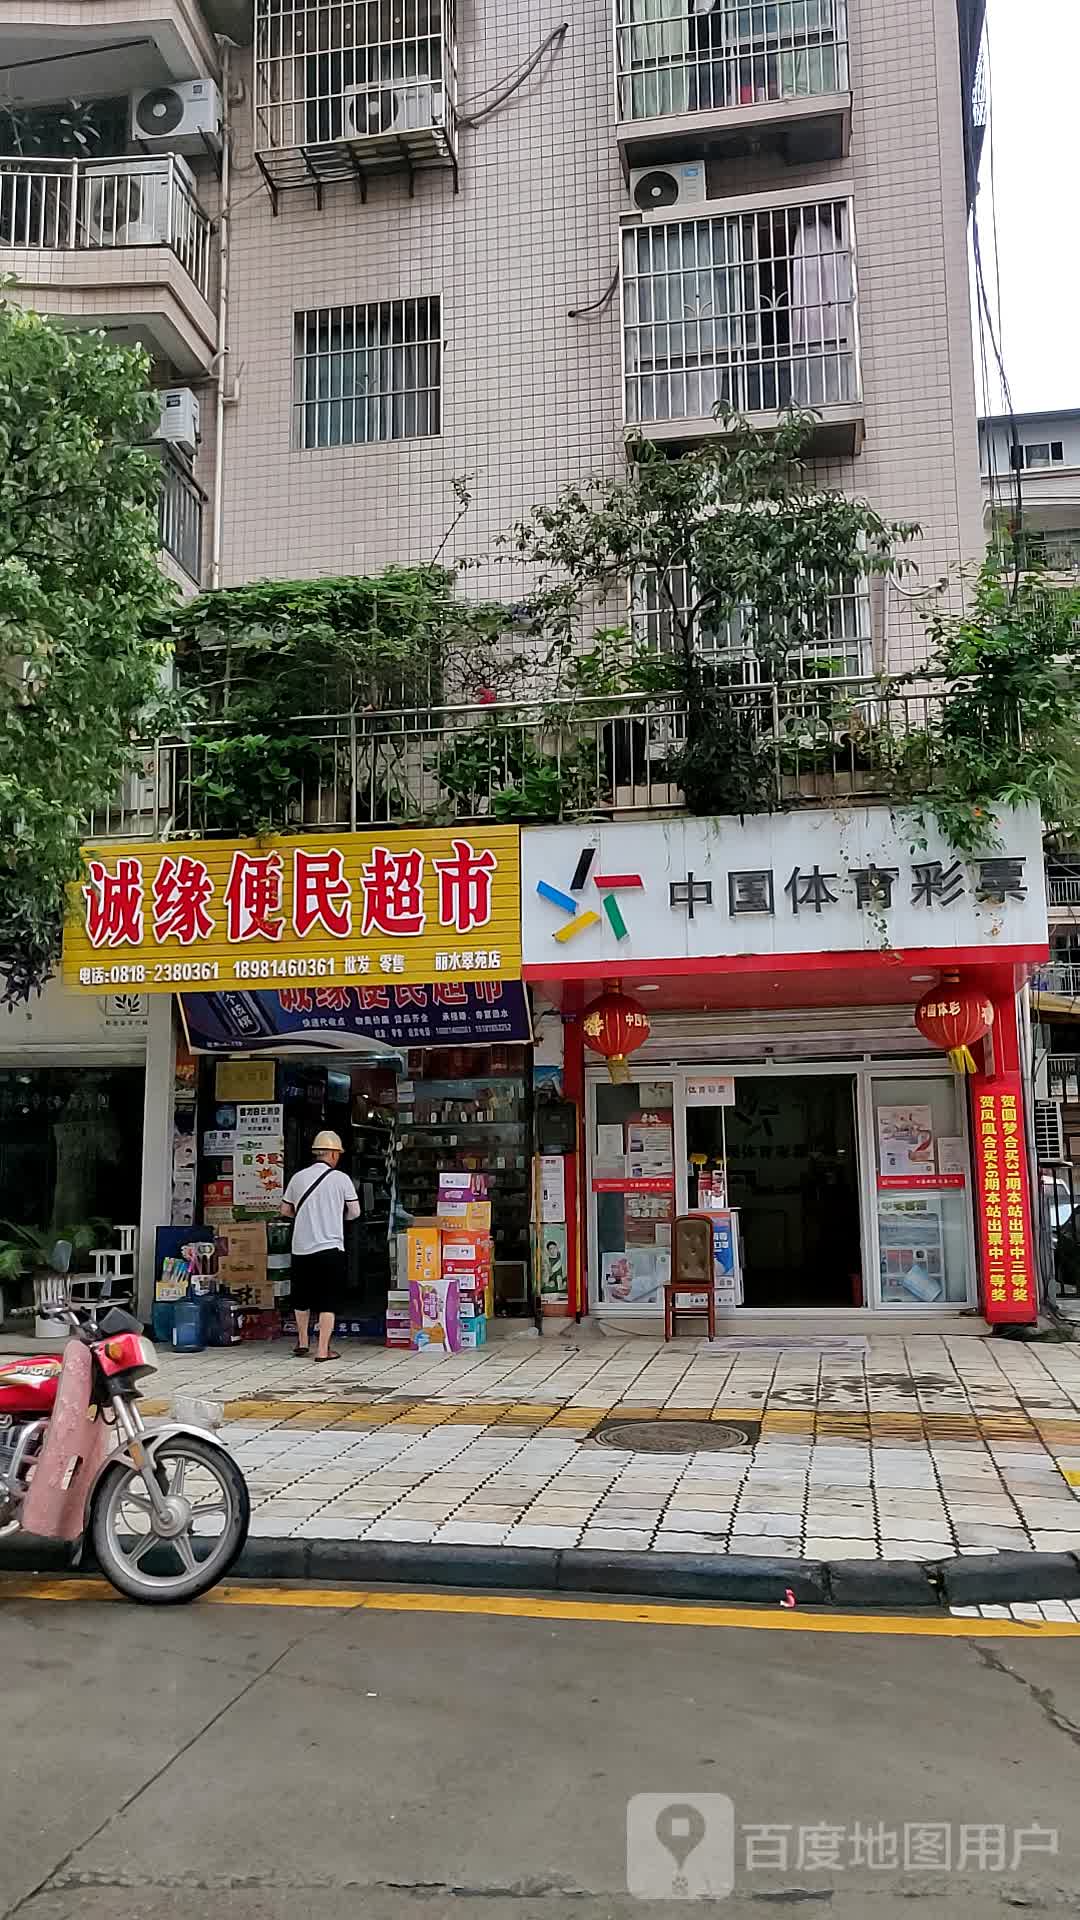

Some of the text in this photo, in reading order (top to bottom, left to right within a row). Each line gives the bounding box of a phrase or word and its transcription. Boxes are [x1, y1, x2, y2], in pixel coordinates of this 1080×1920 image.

[86, 839, 496, 947] 诚缘便民超市
[669, 856, 1028, 919] 中国体育彩票
[79, 950, 502, 985] 电话:0818-2380361 18981460361 批发 零售 丽水翠苑店
